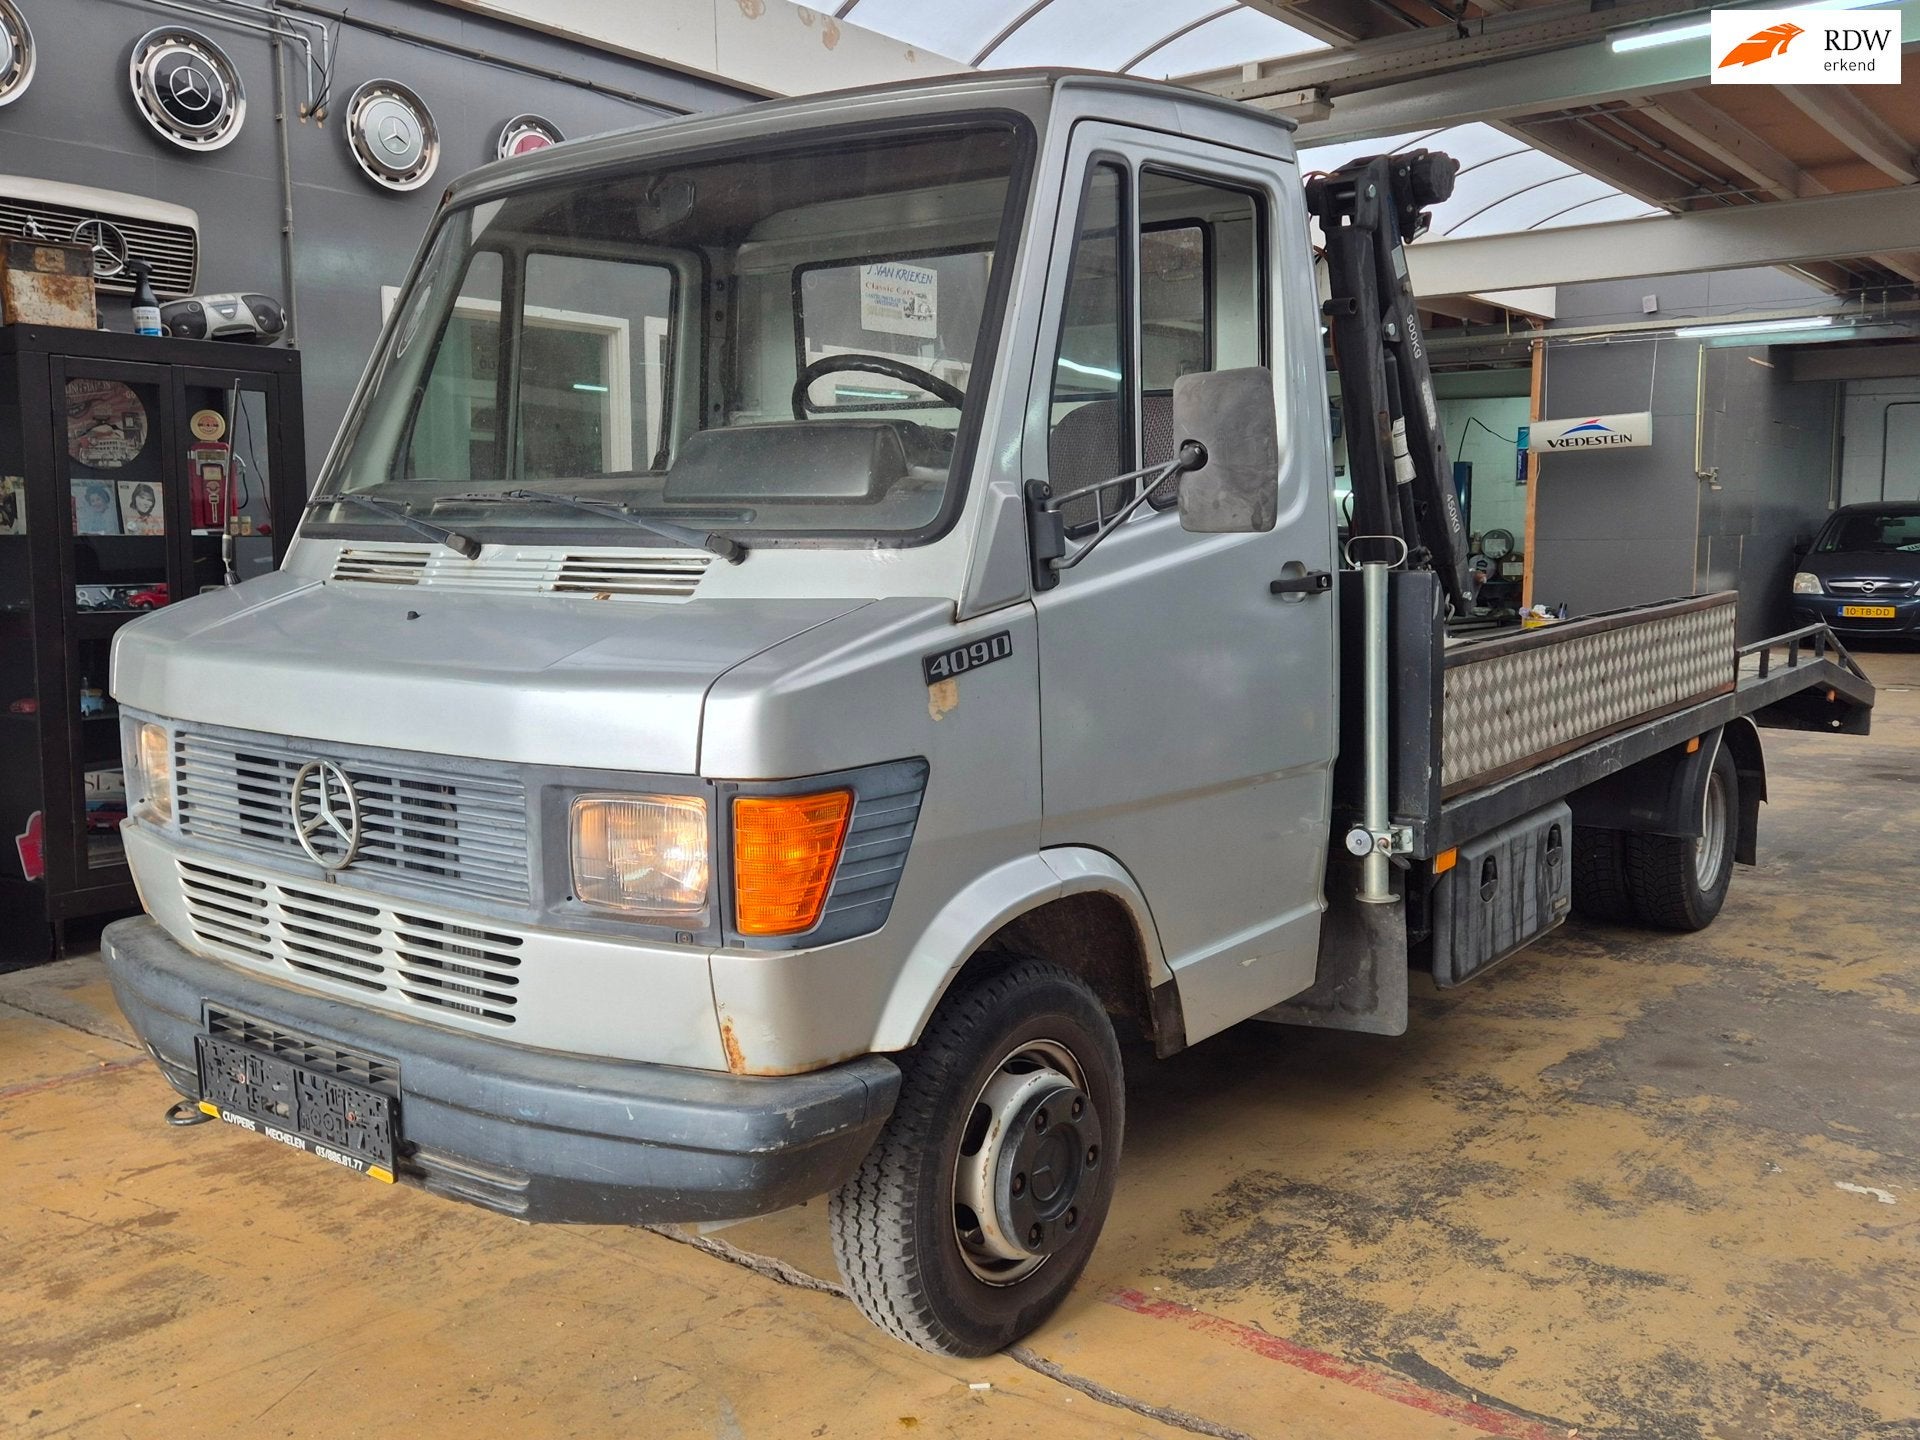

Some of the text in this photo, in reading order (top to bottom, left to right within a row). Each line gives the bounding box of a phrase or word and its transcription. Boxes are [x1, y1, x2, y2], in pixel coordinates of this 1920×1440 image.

[895, 268, 933, 284] KRIEKEN
[865, 281, 914, 296] Classic Cars
[1547, 433, 1633, 448] VREDESTEIN
[1845, 607, 1890, 617] 10-TB-DD
[222, 1110, 256, 1131] CUYPERS
[265, 1126, 306, 1151] MECHELEN
